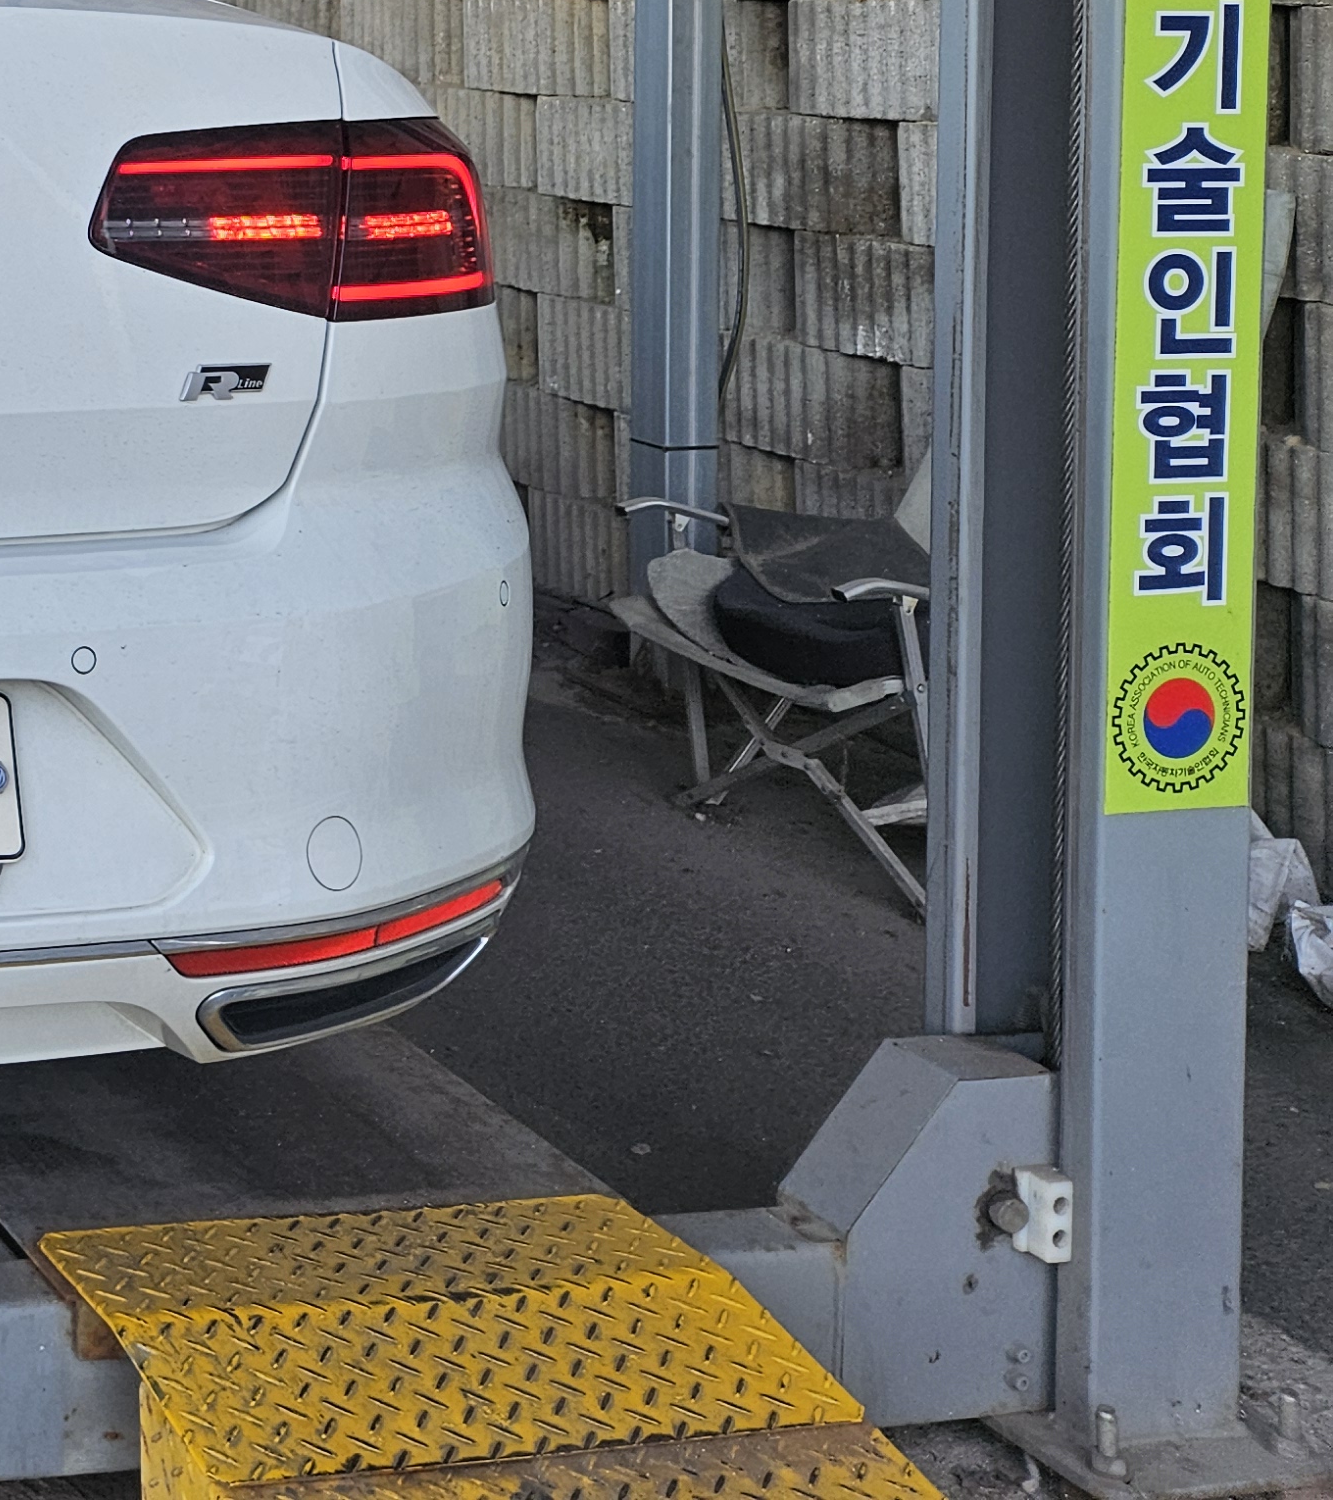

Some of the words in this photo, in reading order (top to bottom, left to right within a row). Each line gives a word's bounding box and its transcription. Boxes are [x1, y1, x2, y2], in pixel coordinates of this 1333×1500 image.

[179, 371, 239, 402] R
[237, 378, 263, 389] Line
[1177, 658, 1192, 669] OF
[1192, 662, 1215, 680] AUTO
[1131, 662, 1176, 711] ASSOCIATION
[1214, 677, 1231, 743] TECHNICIANS
[1126, 711, 1140, 748] KOREA
[1136, 746, 1220, 778] 한국자동차기술인협회
